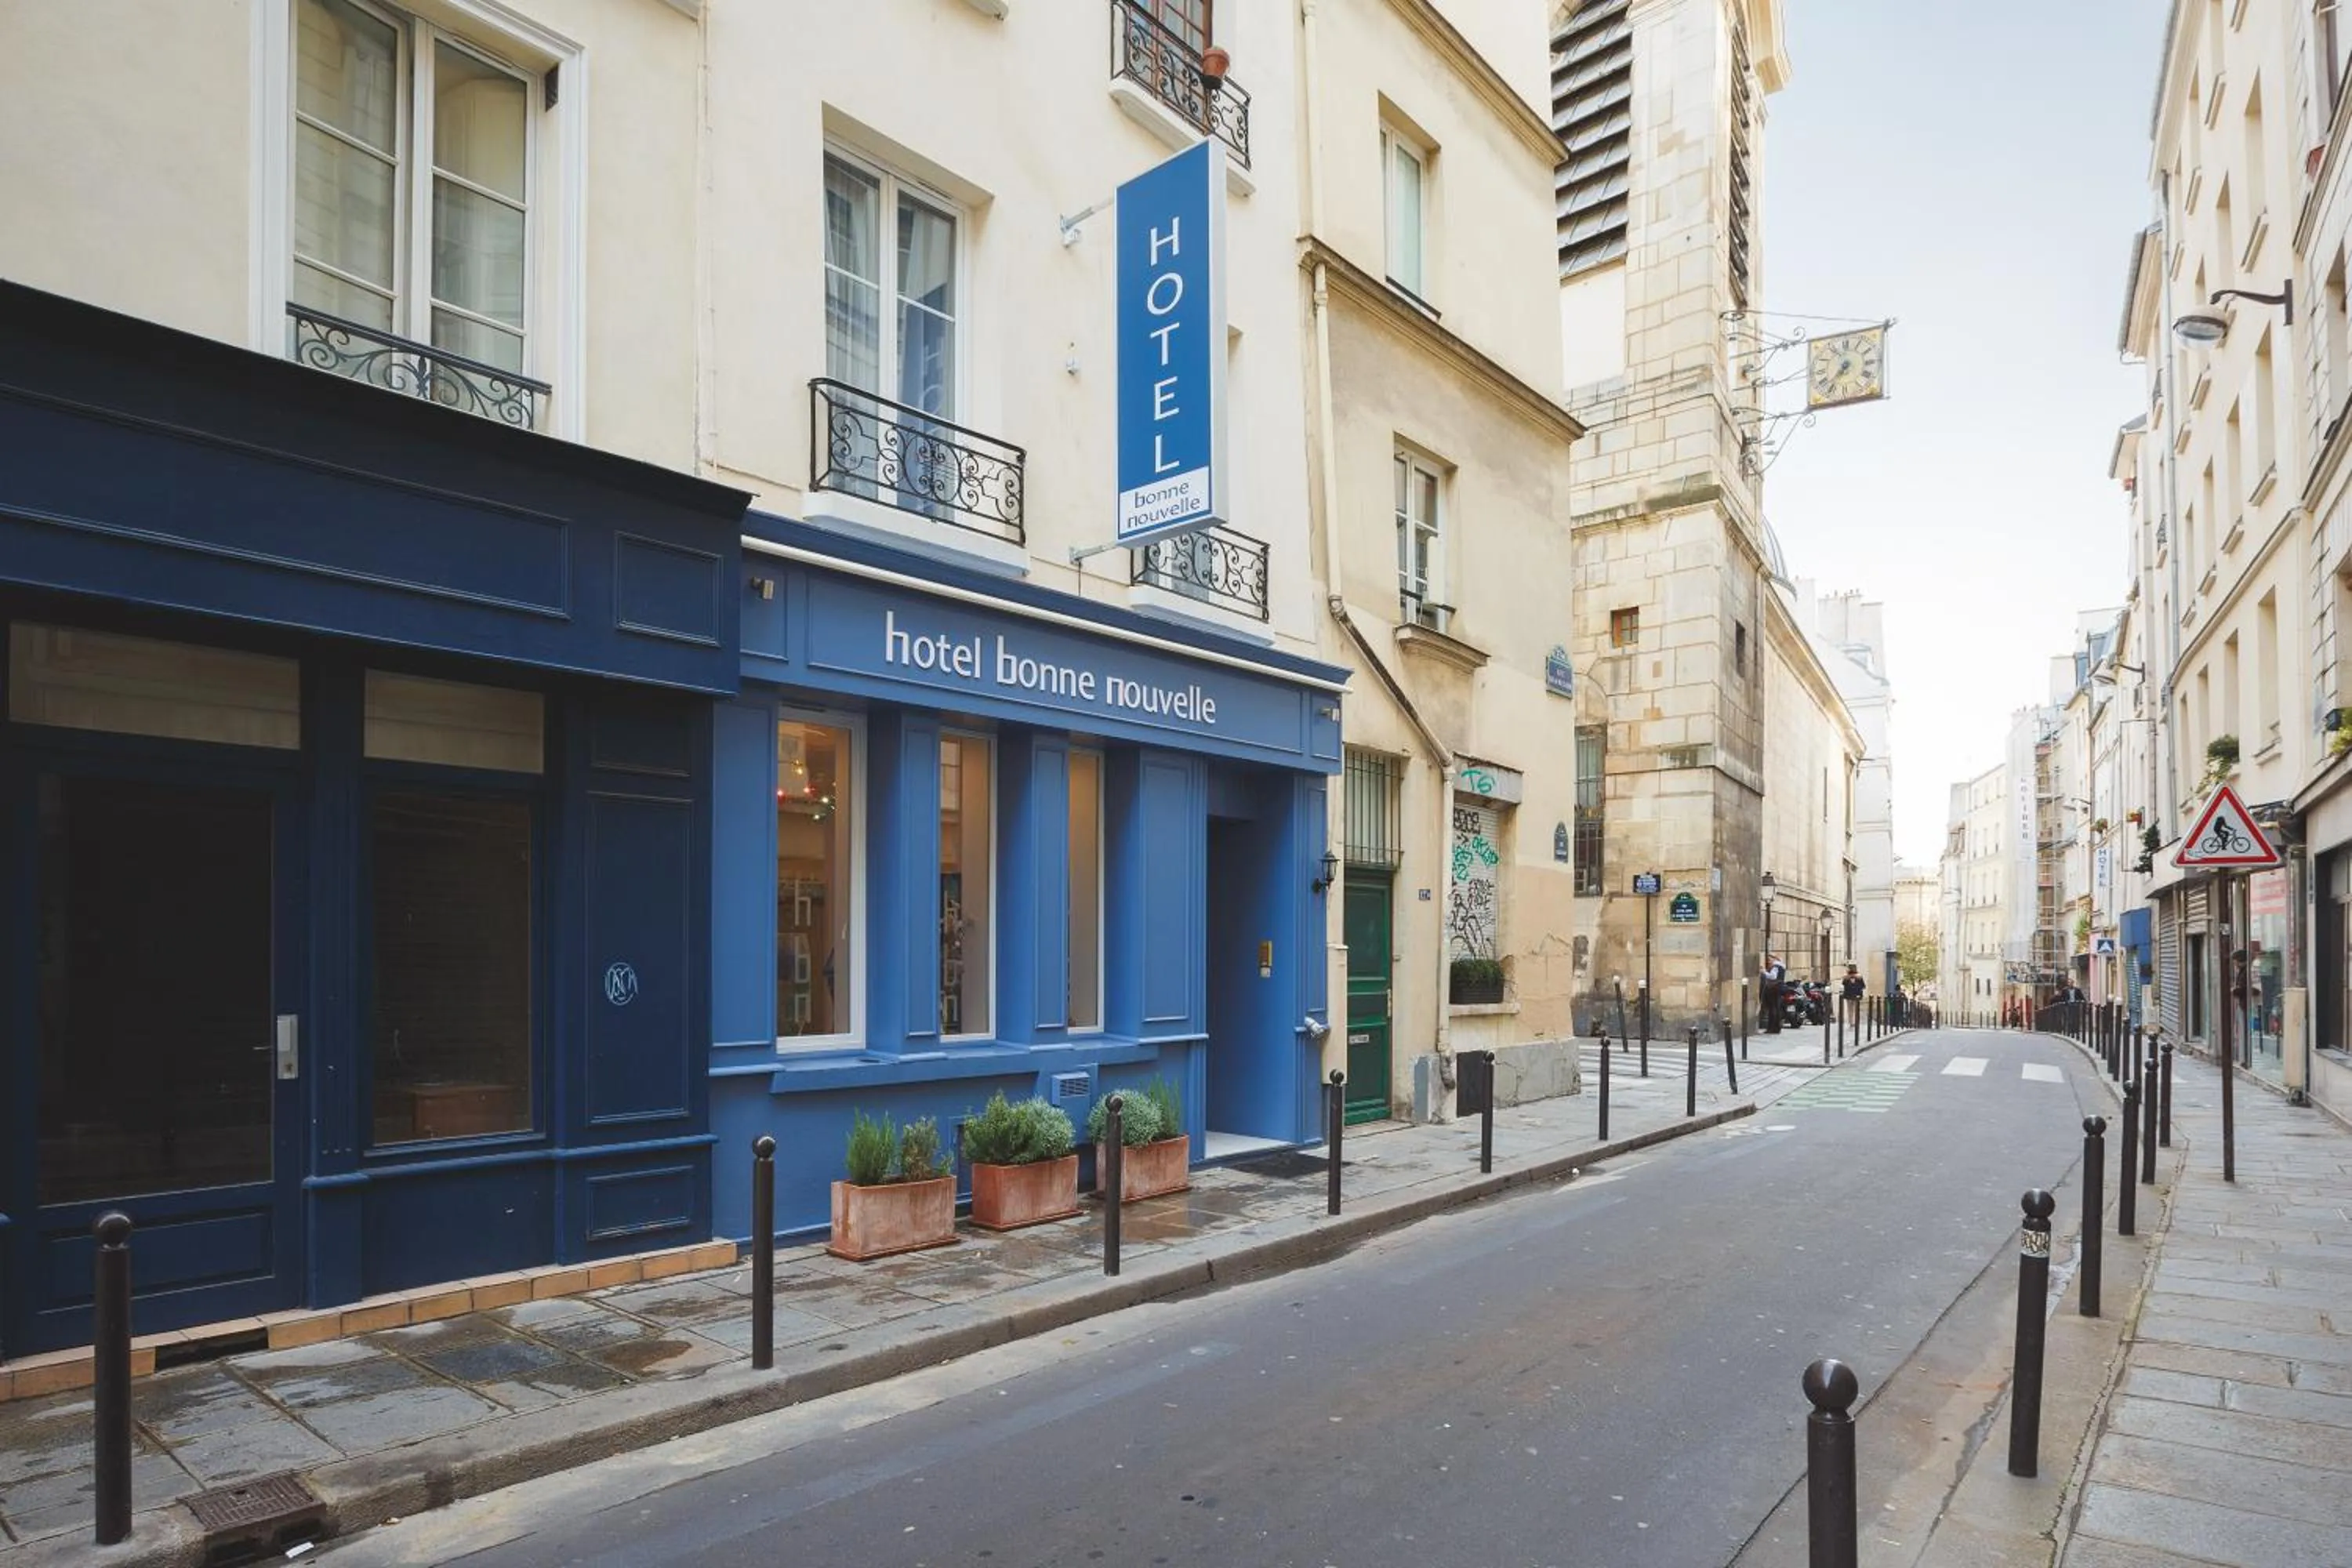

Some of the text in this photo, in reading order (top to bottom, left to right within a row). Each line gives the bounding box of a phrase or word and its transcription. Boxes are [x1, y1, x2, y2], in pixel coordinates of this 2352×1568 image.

[1146, 216, 1184, 473] HOTEL
[1127, 497, 1200, 528] nouvelle
[1134, 483, 1189, 508] bonne
[884, 611, 1216, 724] hotel bonne nouvelle
[2098, 849, 2107, 887] HOTEL
